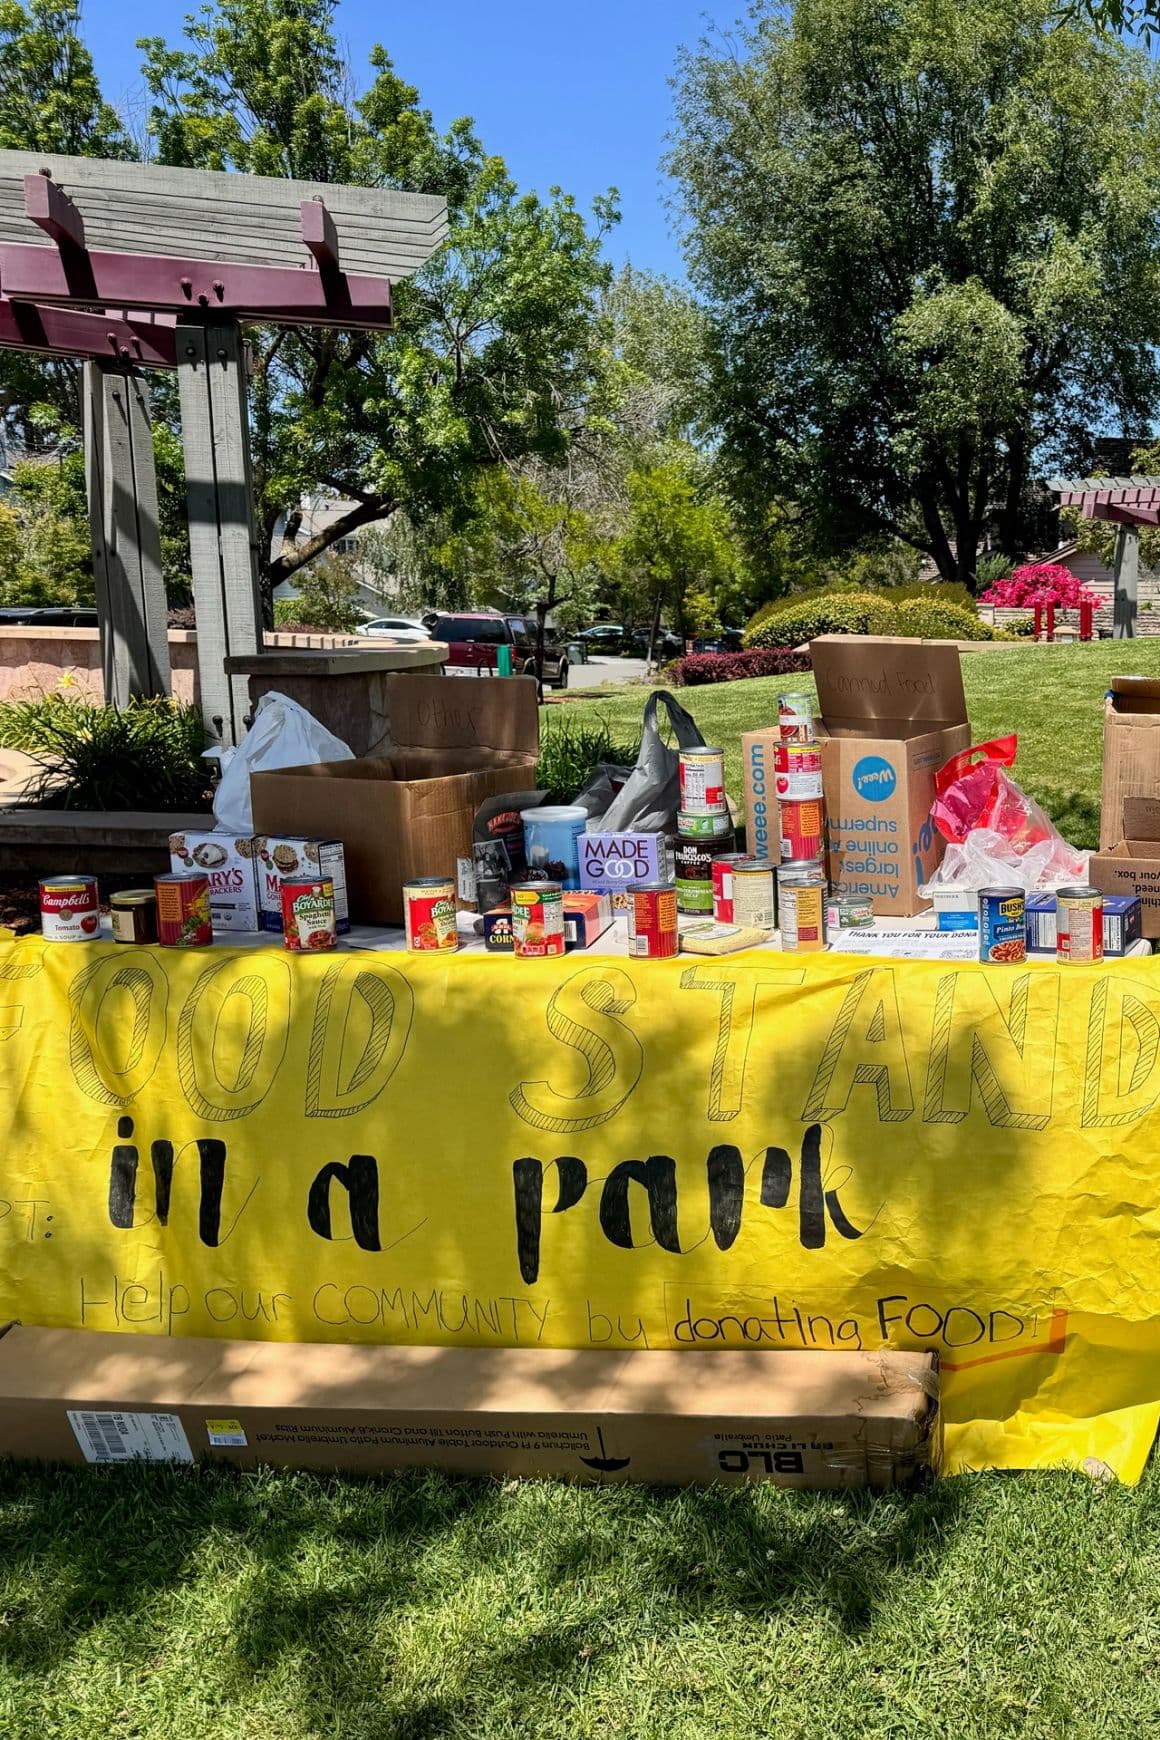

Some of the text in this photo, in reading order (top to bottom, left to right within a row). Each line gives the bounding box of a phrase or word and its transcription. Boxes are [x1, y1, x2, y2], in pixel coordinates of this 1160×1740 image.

[751, 744, 769, 861] weee.com
[828, 815, 897, 833] superm
[585, 840, 649, 859] MADE
[683, 846, 698, 854] DON
[846, 840, 898, 856] online
[586, 860, 650, 879] GOOD
[207, 868, 243, 887] ARY'S
[1114, 870, 1136, 881] box.
[210, 887, 242, 896] RACKERS
[1131, 884, 1160, 895] need.
[42, 892, 90, 908] Campbell's
[848, 930, 878, 938] THANK
[108, 1115, 886, 1284] in a park
[80, 1269, 191, 1336] Help
[204, 1286, 294, 1323] our
[312, 1281, 550, 1342] COMMUNITY
[586, 1297, 649, 1350] by
[673, 1297, 862, 1351] donating
[300, 1425, 355, 1434] Aluminum
[404, 1428, 427, 1436] and
[445, 1429, 482, 1438] Button
[484, 1430, 510, 1439] Push
[255, 1434, 296, 1443] Market
[297, 1435, 348, 1445] Umbrella
[349, 1436, 379, 1445] Patio
[512, 1431, 536, 1440] with
[380, 1437, 435, 1447] Aluminum
[438, 1439, 470, 1448] Table
[472, 1440, 518, 1449] Outdoor
[718, 1450, 804, 1474] BLC
